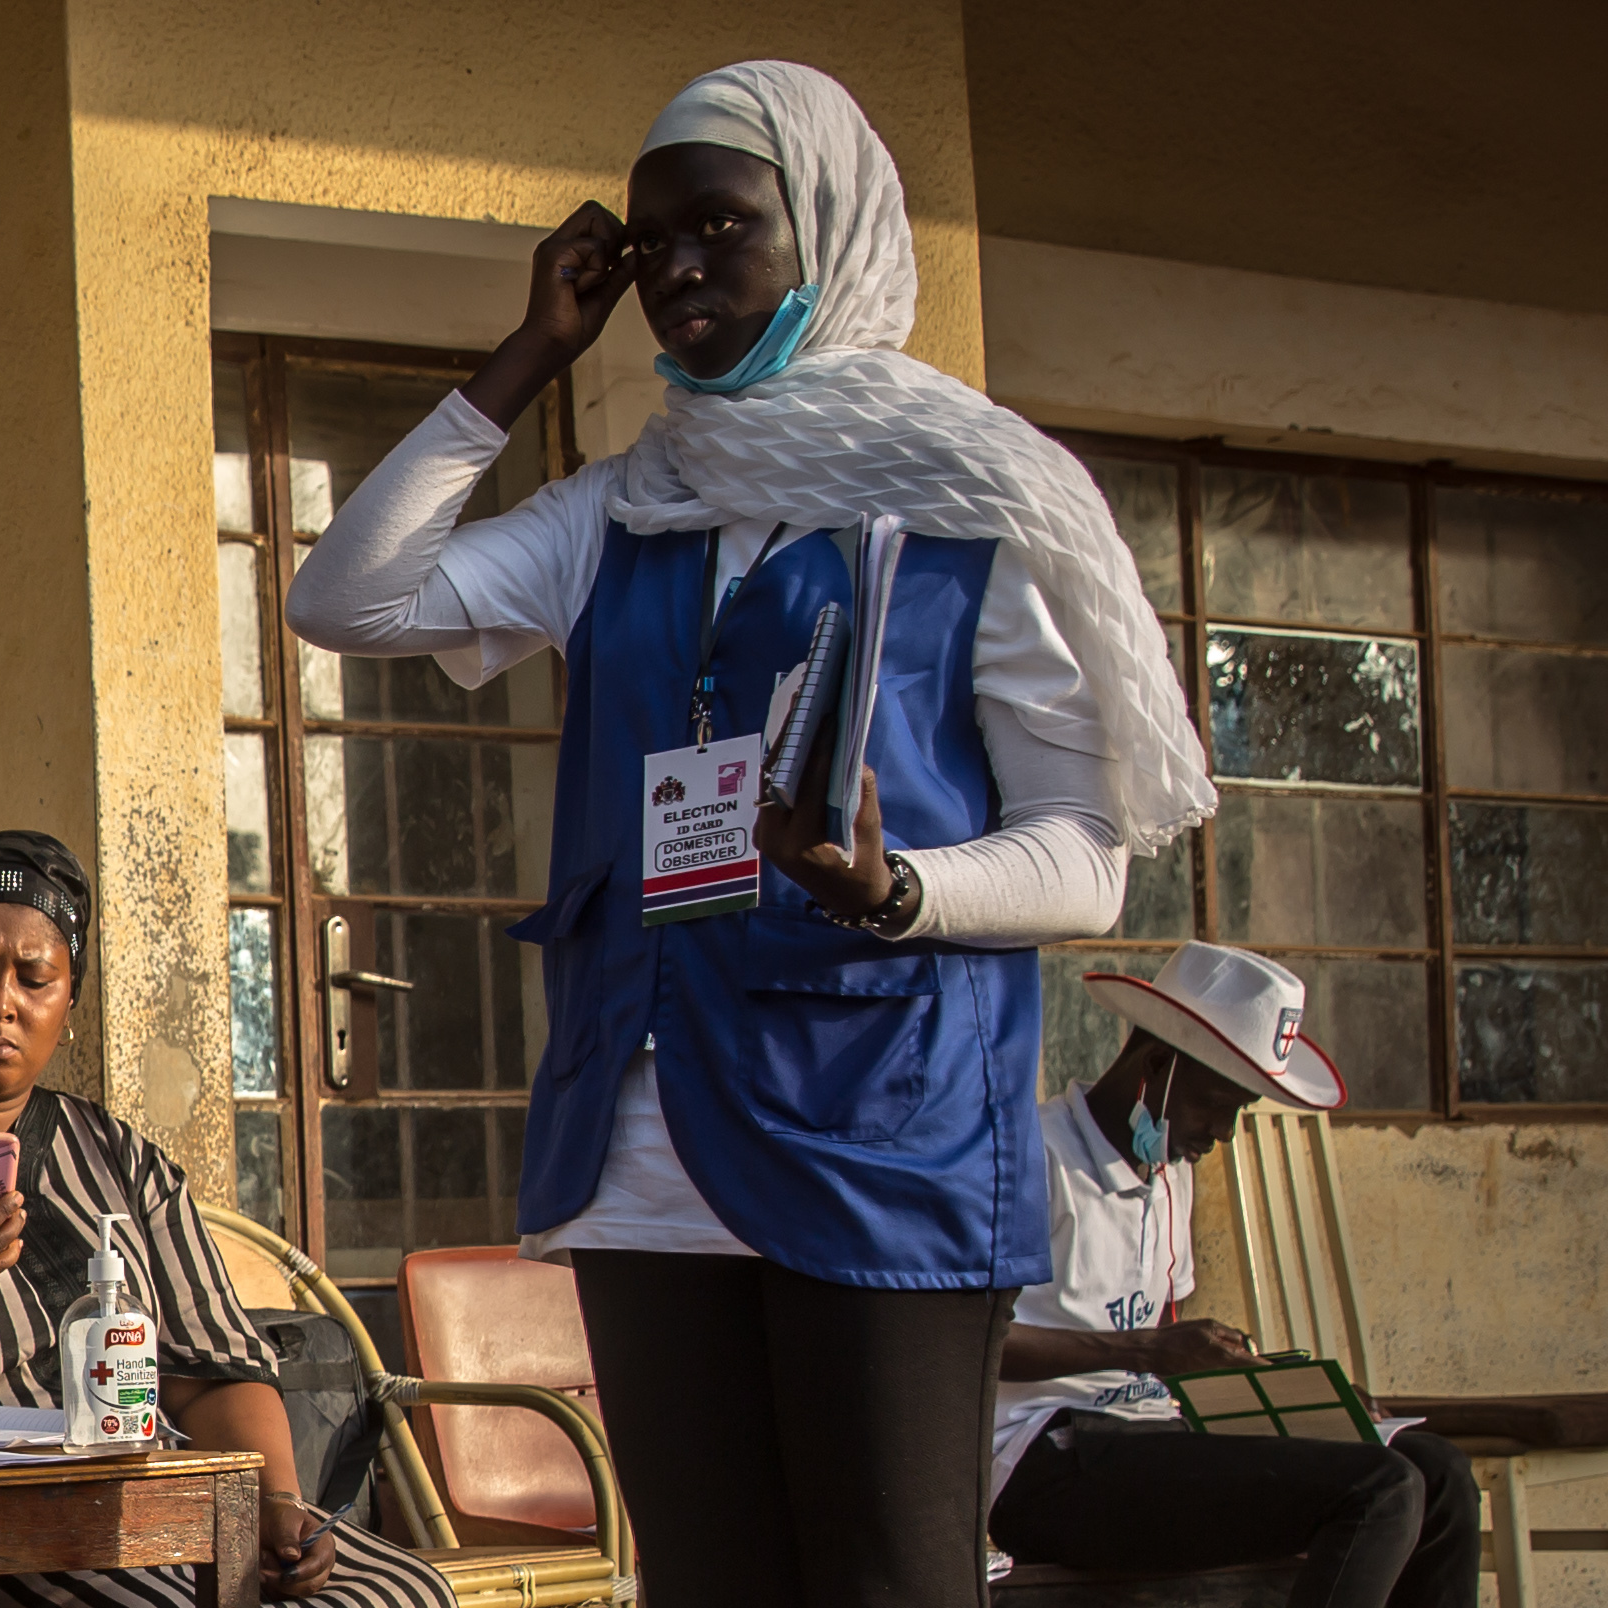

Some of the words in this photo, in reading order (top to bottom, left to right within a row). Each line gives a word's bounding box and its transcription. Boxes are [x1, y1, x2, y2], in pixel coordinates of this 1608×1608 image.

[663, 800, 738, 824] ELECTION
[676, 825, 689, 836] ID
[692, 818, 723, 832] CARD
[663, 832, 736, 855] DOMESTIC
[661, 846, 738, 869] OBSERVER
[110, 1331, 142, 1343] DYNA
[116, 1358, 144, 1369] Hand
